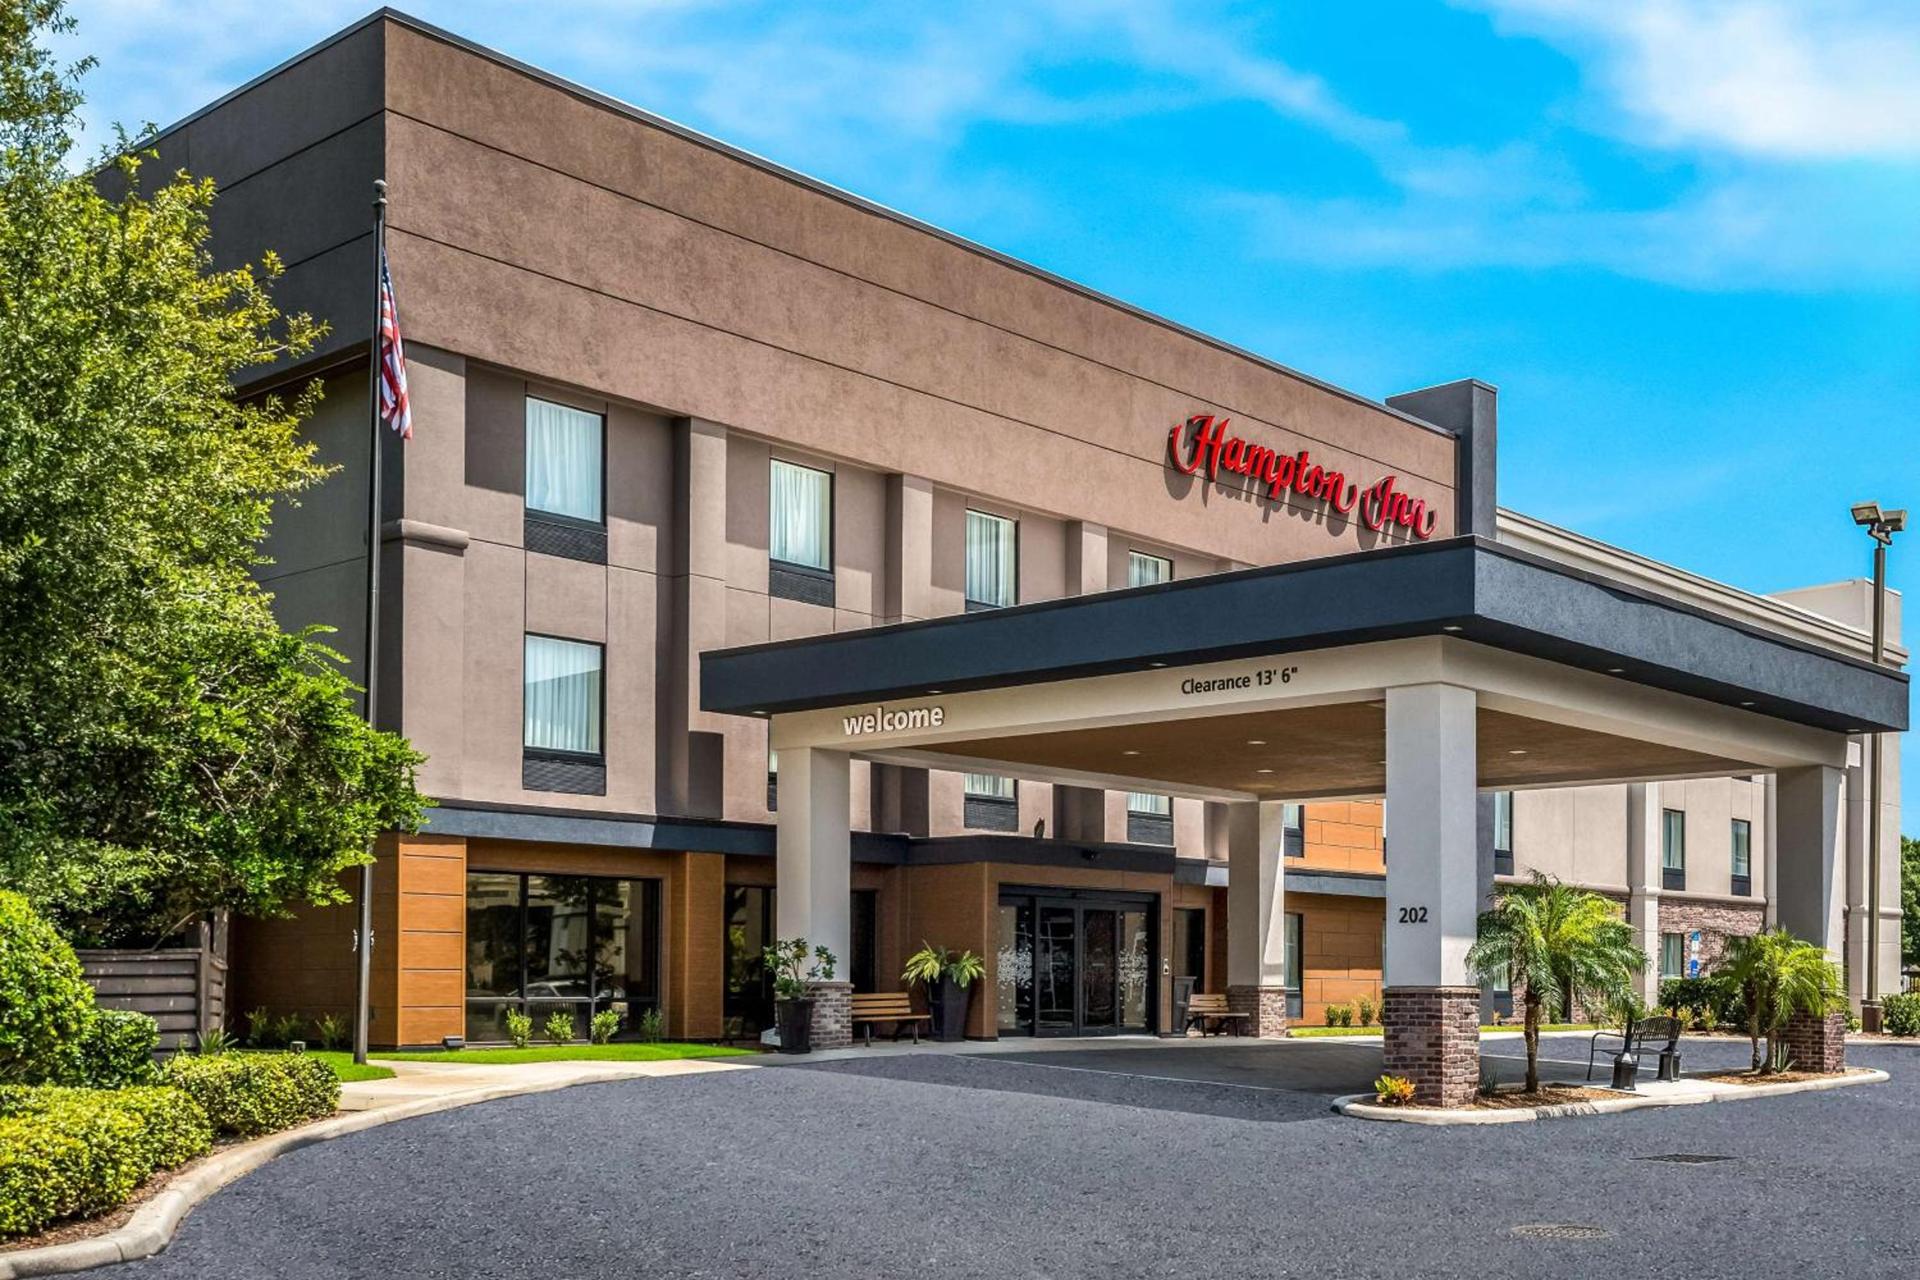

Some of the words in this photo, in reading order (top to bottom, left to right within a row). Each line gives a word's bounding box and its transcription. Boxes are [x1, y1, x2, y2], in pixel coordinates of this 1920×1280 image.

[1168, 415, 1358, 513] Hampton
[1362, 475, 1438, 540] Inn
[1181, 676, 1251, 694] Clearance
[1256, 669, 1277, 686] 13'
[1281, 667, 1298, 683] 6"
[842, 705, 945, 735] welcome
[1399, 906, 1428, 923] 202
